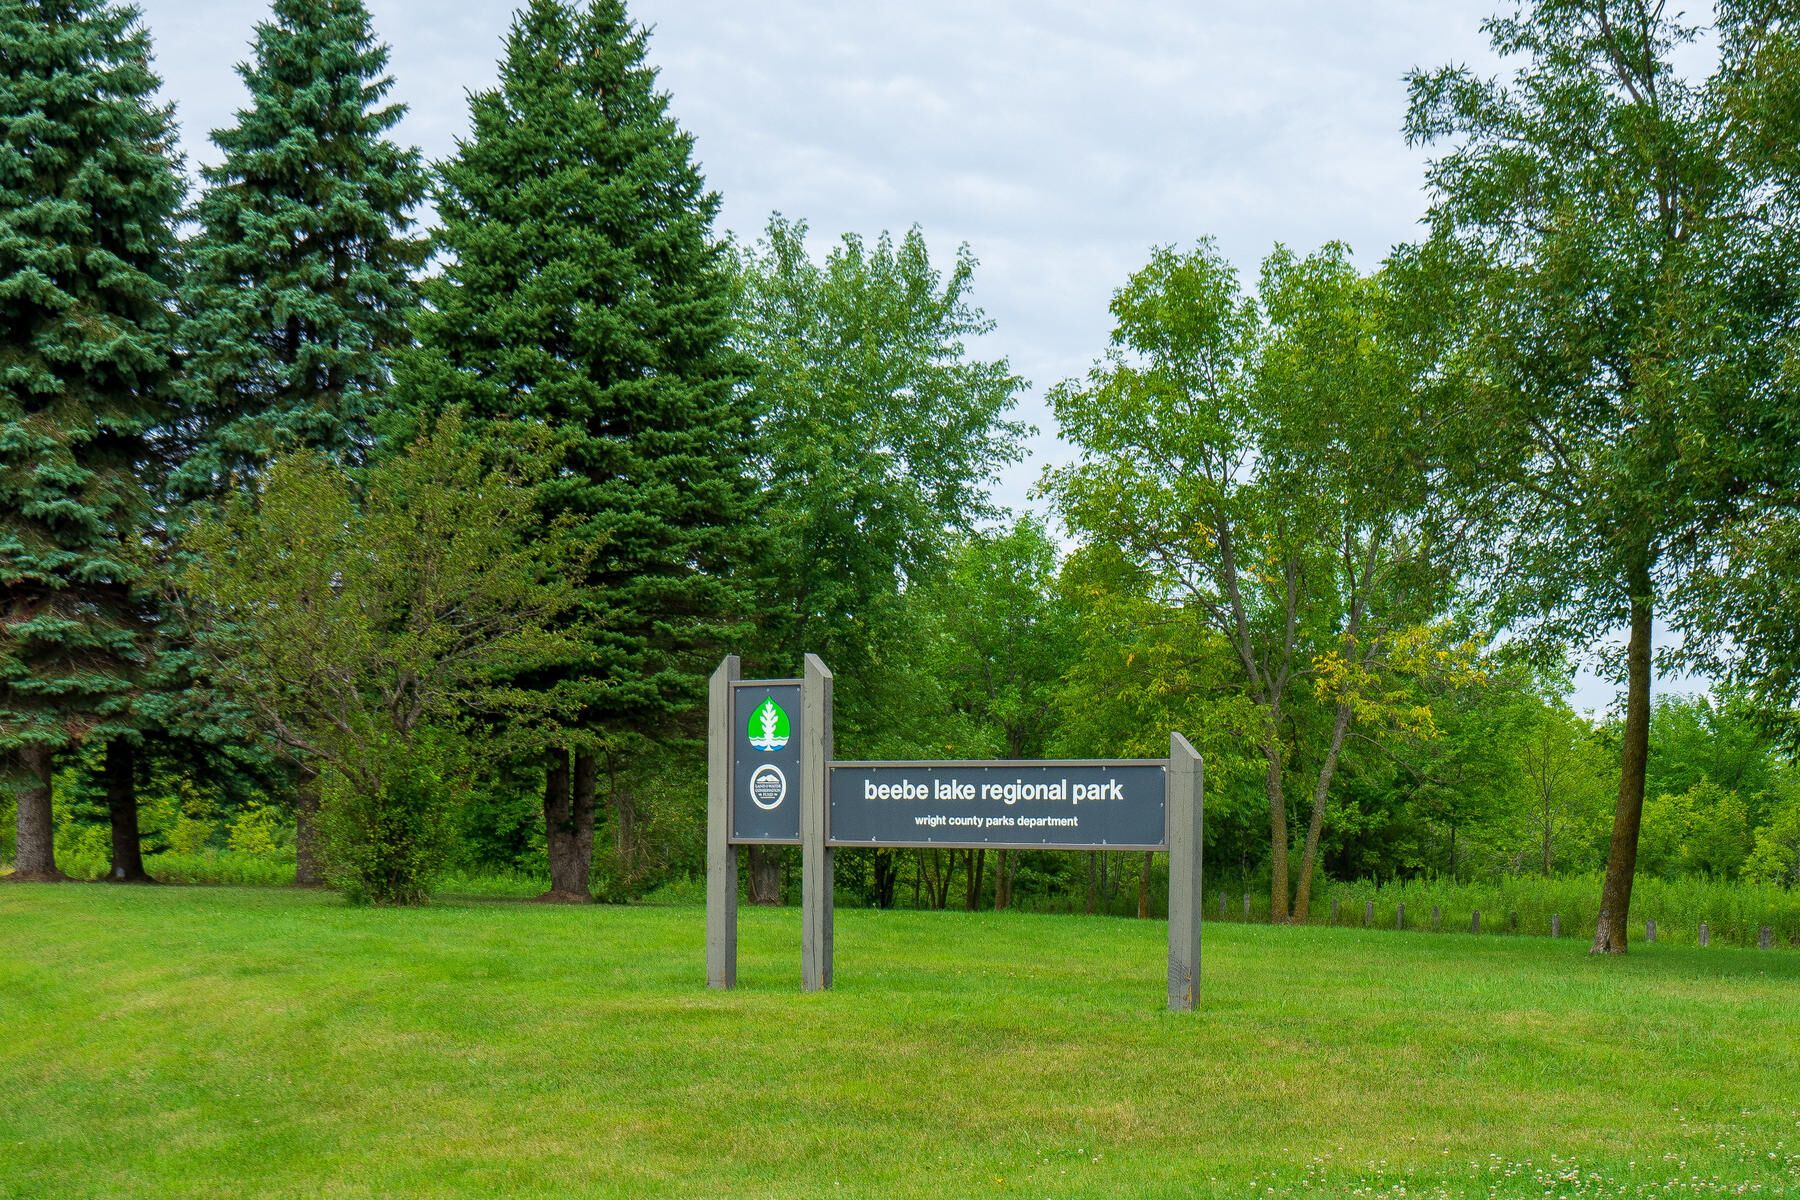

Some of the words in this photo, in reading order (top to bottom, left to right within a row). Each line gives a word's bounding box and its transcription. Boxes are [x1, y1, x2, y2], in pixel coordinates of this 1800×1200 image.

[864, 778, 929, 800] beebe
[934, 778, 976, 800] lake
[982, 778, 1067, 804] regional
[1072, 778, 1124, 804] park
[914, 815, 947, 828] wright
[948, 816, 984, 828] county
[985, 815, 1015, 828] parks
[1016, 815, 1079, 828] department
